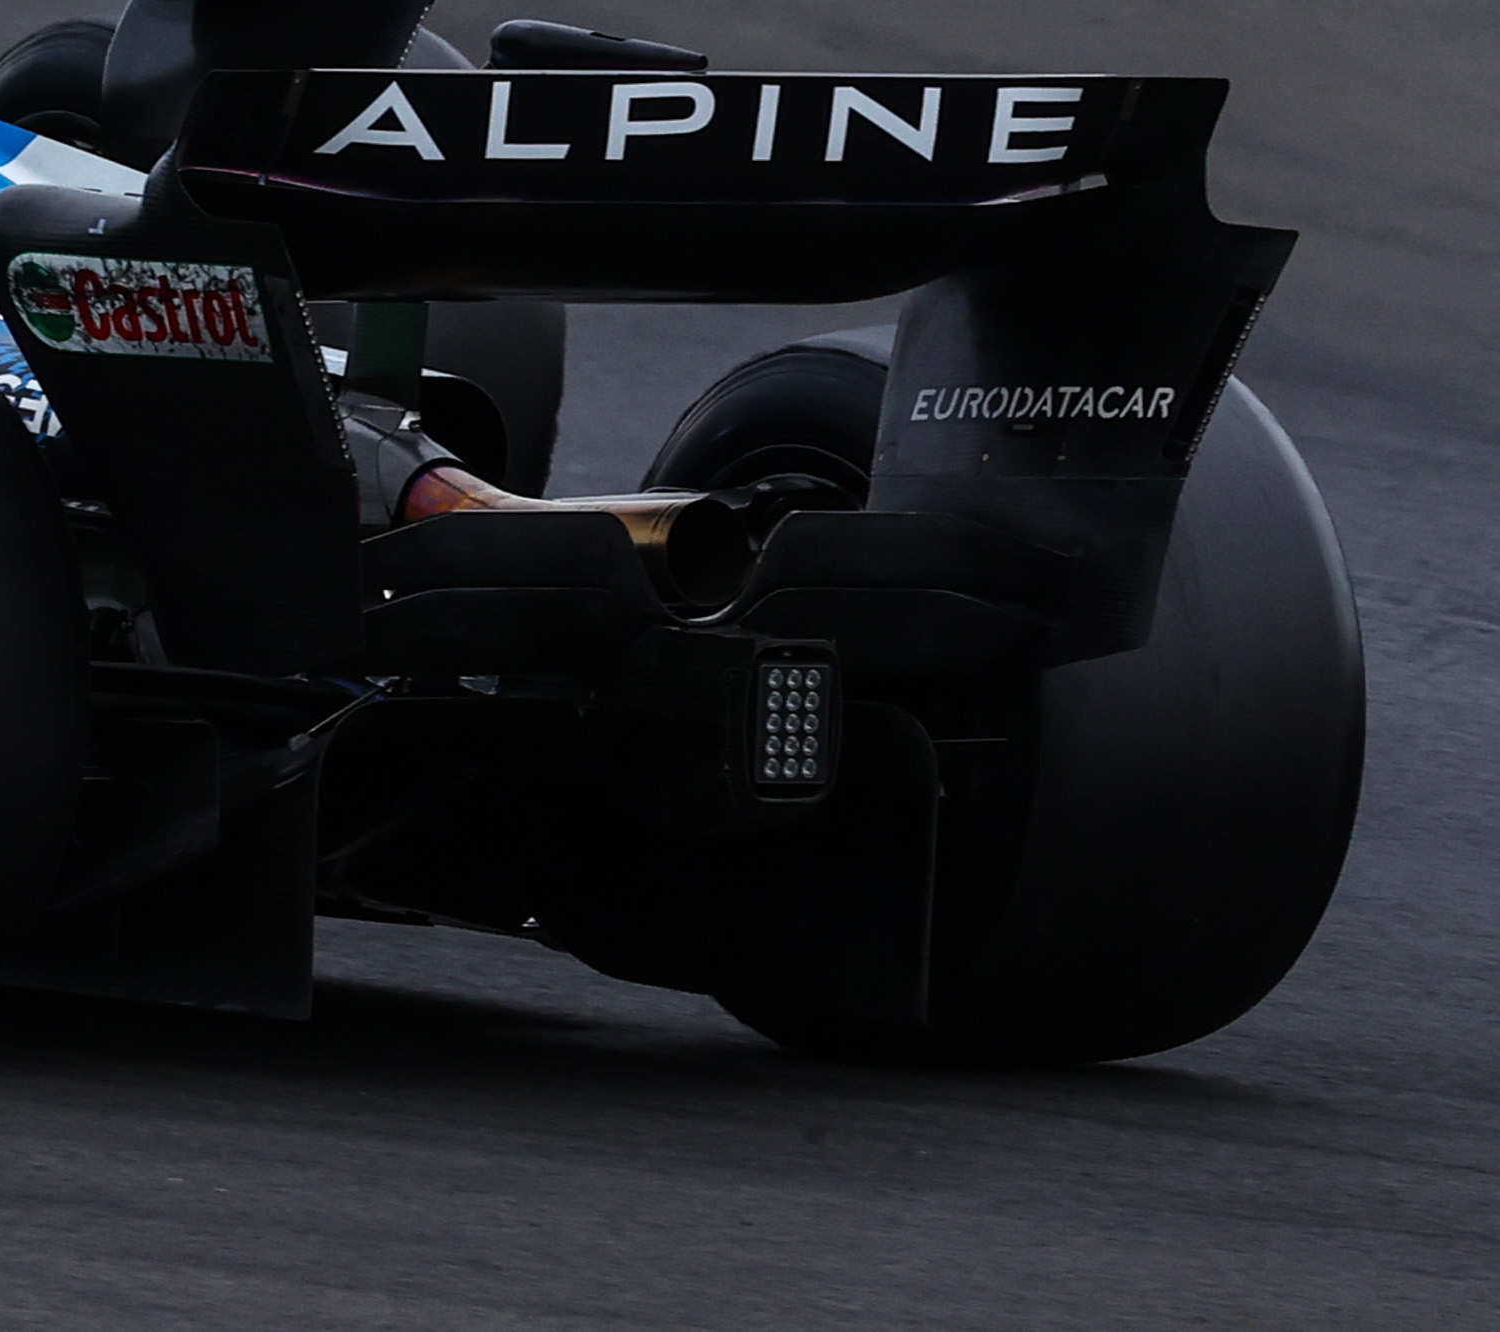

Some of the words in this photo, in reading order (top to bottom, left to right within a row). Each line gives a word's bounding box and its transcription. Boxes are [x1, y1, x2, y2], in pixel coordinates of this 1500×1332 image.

[311, 80, 1085, 164] ALPINE
[74, 268, 259, 347] Castrol
[910, 386, 1176, 421] EURODATACAR
